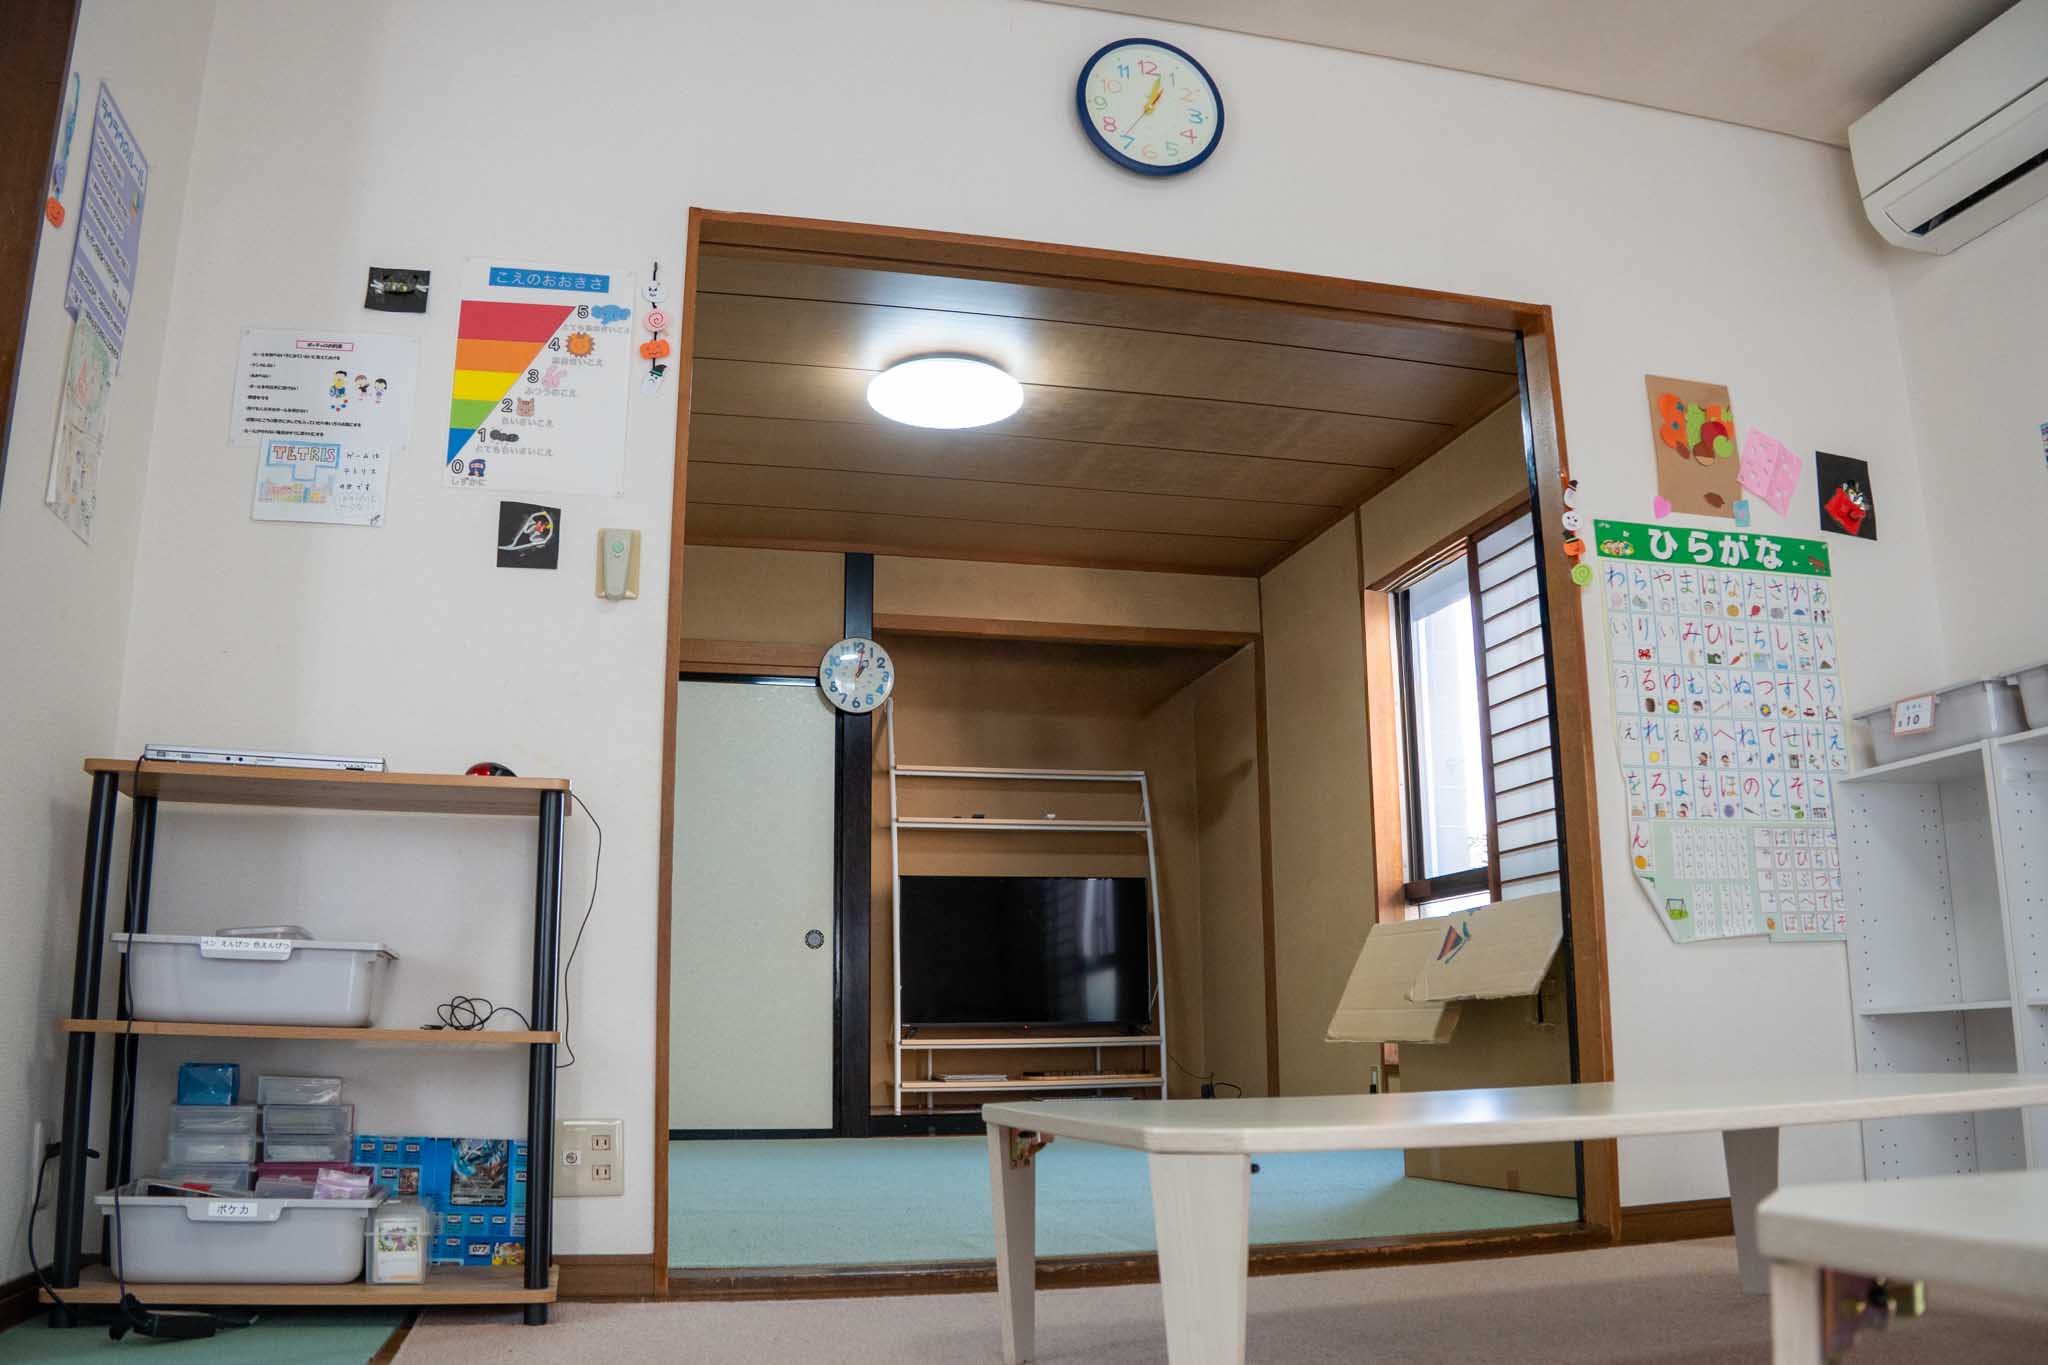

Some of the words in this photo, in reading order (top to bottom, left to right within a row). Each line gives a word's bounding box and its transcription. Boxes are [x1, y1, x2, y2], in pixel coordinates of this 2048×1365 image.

[1117, 64, 1130, 79] 11
[1138, 60, 1158, 76] 12
[1169, 72, 1175, 86] 1
[1103, 80, 1122, 93] 10
[1094, 96, 1108, 110] 9
[1187, 109, 1203, 124] 3
[1103, 116, 1117, 132] 8
[1120, 134, 1136, 150] 7
[1180, 129, 1197, 143] 4
[1143, 144, 1157, 159] 6
[1166, 142, 1178, 156] 5
[497, 271, 603, 290] こえのおおきさ
[577, 305, 589, 318] 5
[548, 338, 560, 351] 4
[528, 369, 539, 383] 3
[501, 398, 513, 412] 2
[478, 428, 486, 442] 1
[273, 444, 337, 463] TETRIS
[452, 459, 464, 473] 0
[1648, 528, 1784, 569] ひらがな
[1607, 565, 1625, 588] わ
[1635, 568, 1647, 590] ら
[1654, 569, 1672, 592] や
[1680, 570, 1694, 593] ま
[1701, 575, 1717, 595] は
[1723, 576, 1739, 597] な
[1747, 576, 1763, 599] た
[1768, 578, 1783, 600] さ
[1790, 583, 1806, 602] か
[1813, 582, 1827, 605] あ
[1638, 618, 1648, 640] り
[1682, 622, 1702, 644] み
[1705, 624, 1722, 644] ひ
[1729, 625, 1745, 645] に
[1753, 626, 1766, 649] ち
[1776, 628, 1788, 650] し
[1798, 630, 1809, 651] き
[1816, 633, 1832, 649] い
[870, 648, 873, 658] 1
[877, 657, 885, 668] 2
[825, 668, 832, 678] 9
[830, 681, 838, 692] 8
[876, 684, 884, 694] 4
[1642, 669, 1656, 691] る
[1664, 668, 1681, 693] ゆ
[1688, 672, 1703, 694] む
[1710, 674, 1728, 694] ふ
[1734, 675, 1751, 694] ぬ
[1756, 680, 1774, 695] つ
[1778, 676, 1795, 699] す
[1804, 679, 1814, 700] く
[1824, 679, 1835, 701] う
[839, 693, 848, 704] 7
[852, 697, 860, 708] 6
[866, 694, 874, 705] 5
[1643, 720, 1664, 744] れ
[1694, 724, 1708, 742] め
[1713, 729, 1736, 741] へ
[1739, 723, 1757, 748] ね
[1761, 727, 1776, 747] て
[1783, 728, 1800, 748] せ
[1807, 726, 1823, 749] け
[1830, 728, 1845, 750] え
[1627, 770, 1640, 796] を
[1651, 773, 1666, 796] ろ
[1675, 771, 1688, 796] よ
[1699, 774, 1712, 797] も
[1721, 775, 1737, 797] ほ
[1743, 778, 1759, 797] の
[1768, 778, 1781, 797] と
[1790, 777, 1804, 799] そ
[1813, 779, 1825, 798] こ
[1632, 824, 1648, 848] ん
[215, 1204, 250, 1215] ポケカ
